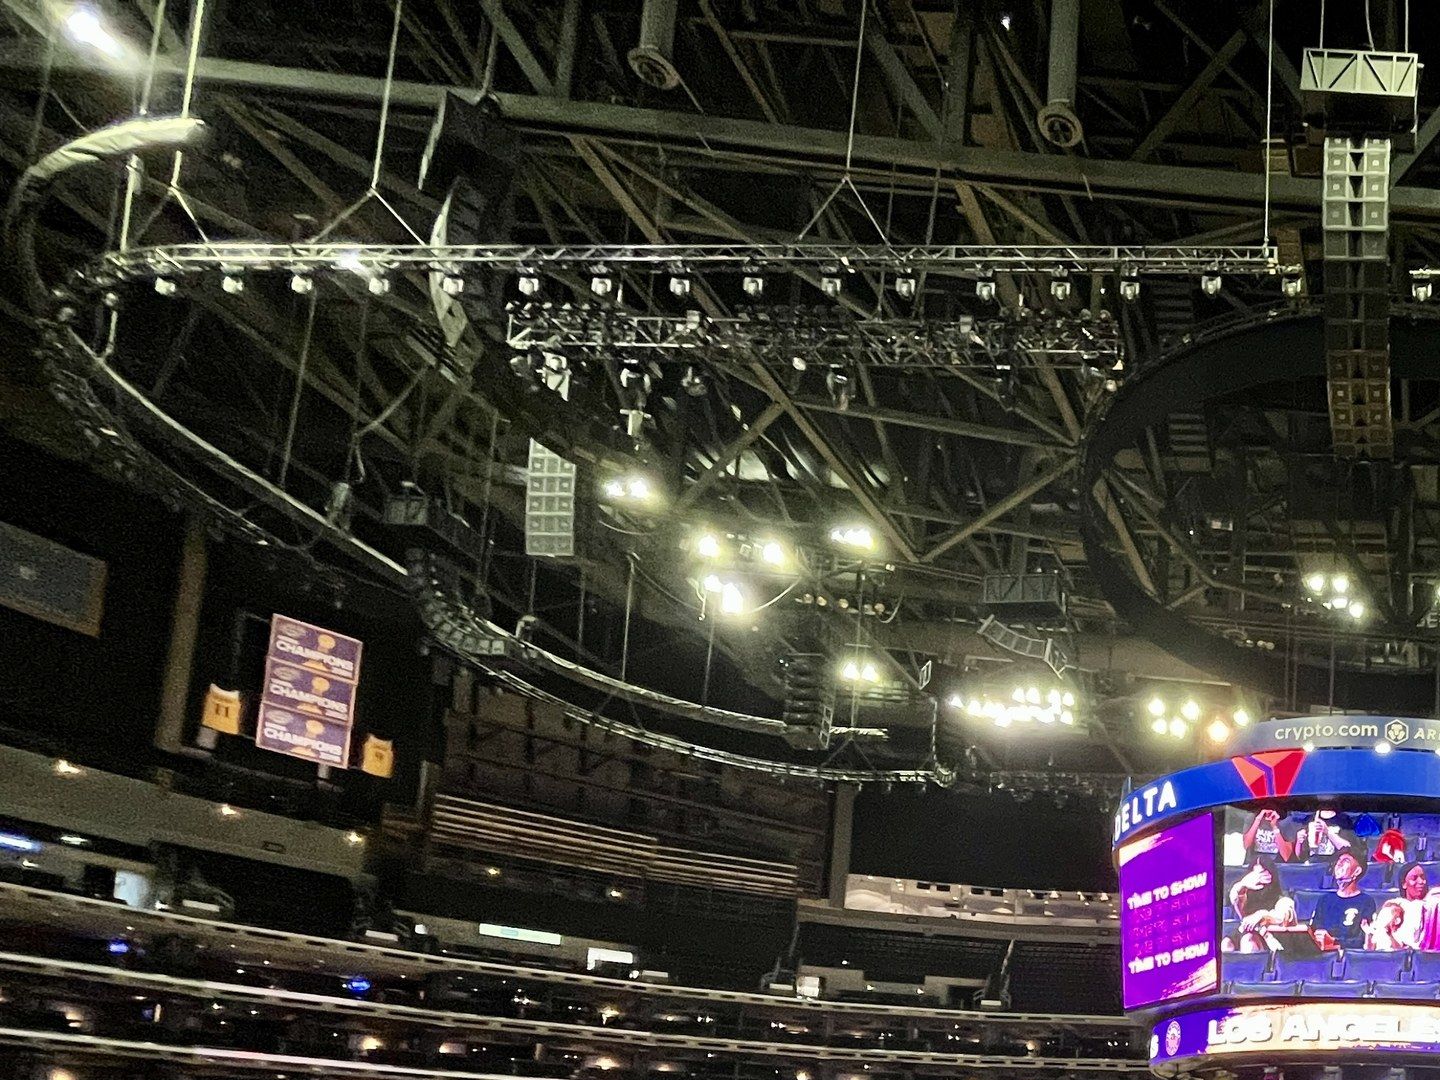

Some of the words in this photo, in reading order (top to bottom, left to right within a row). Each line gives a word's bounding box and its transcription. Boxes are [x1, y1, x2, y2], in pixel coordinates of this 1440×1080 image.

[276, 640, 354, 671] CHAMPIONS
[270, 683, 348, 713] CHAMPIONS
[264, 726, 342, 755] CHAMPIONS
[1274, 724, 1378, 741] crypto.com
[1115, 781, 1177, 842] DELTA
[1153, 885, 1169, 902] TO
[1170, 871, 1207, 897] SHOW
[1155, 951, 1171, 968] TO
[1172, 941, 1209, 964] SHOW
[1207, 1013, 1273, 1045] LOS
